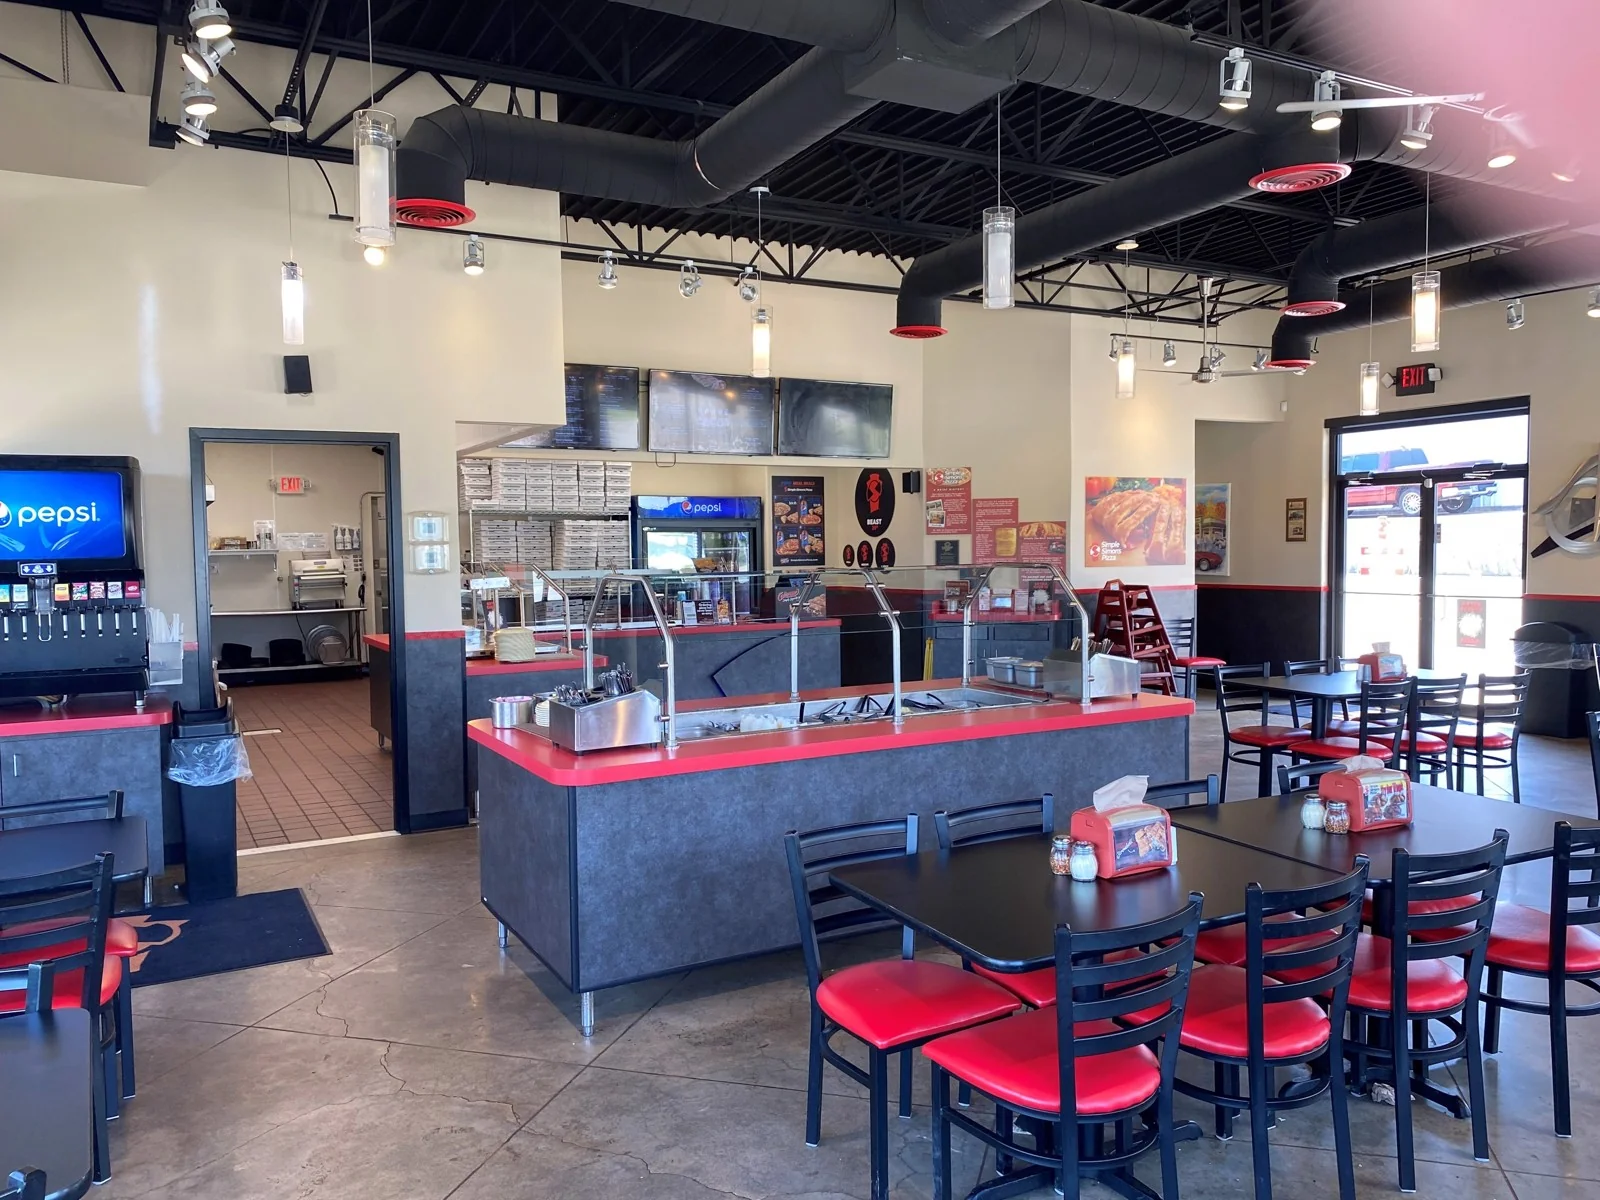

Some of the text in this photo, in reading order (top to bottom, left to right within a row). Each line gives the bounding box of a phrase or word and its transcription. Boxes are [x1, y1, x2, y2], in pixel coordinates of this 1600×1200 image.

[1402, 367, 1425, 387] EXIT
[281, 477, 301, 492] EXIT
[18, 501, 97, 527] pepsi
[694, 503, 722, 513] pepsi
[866, 518, 882, 526] BEAST
[1101, 541, 1121, 549] Simple
